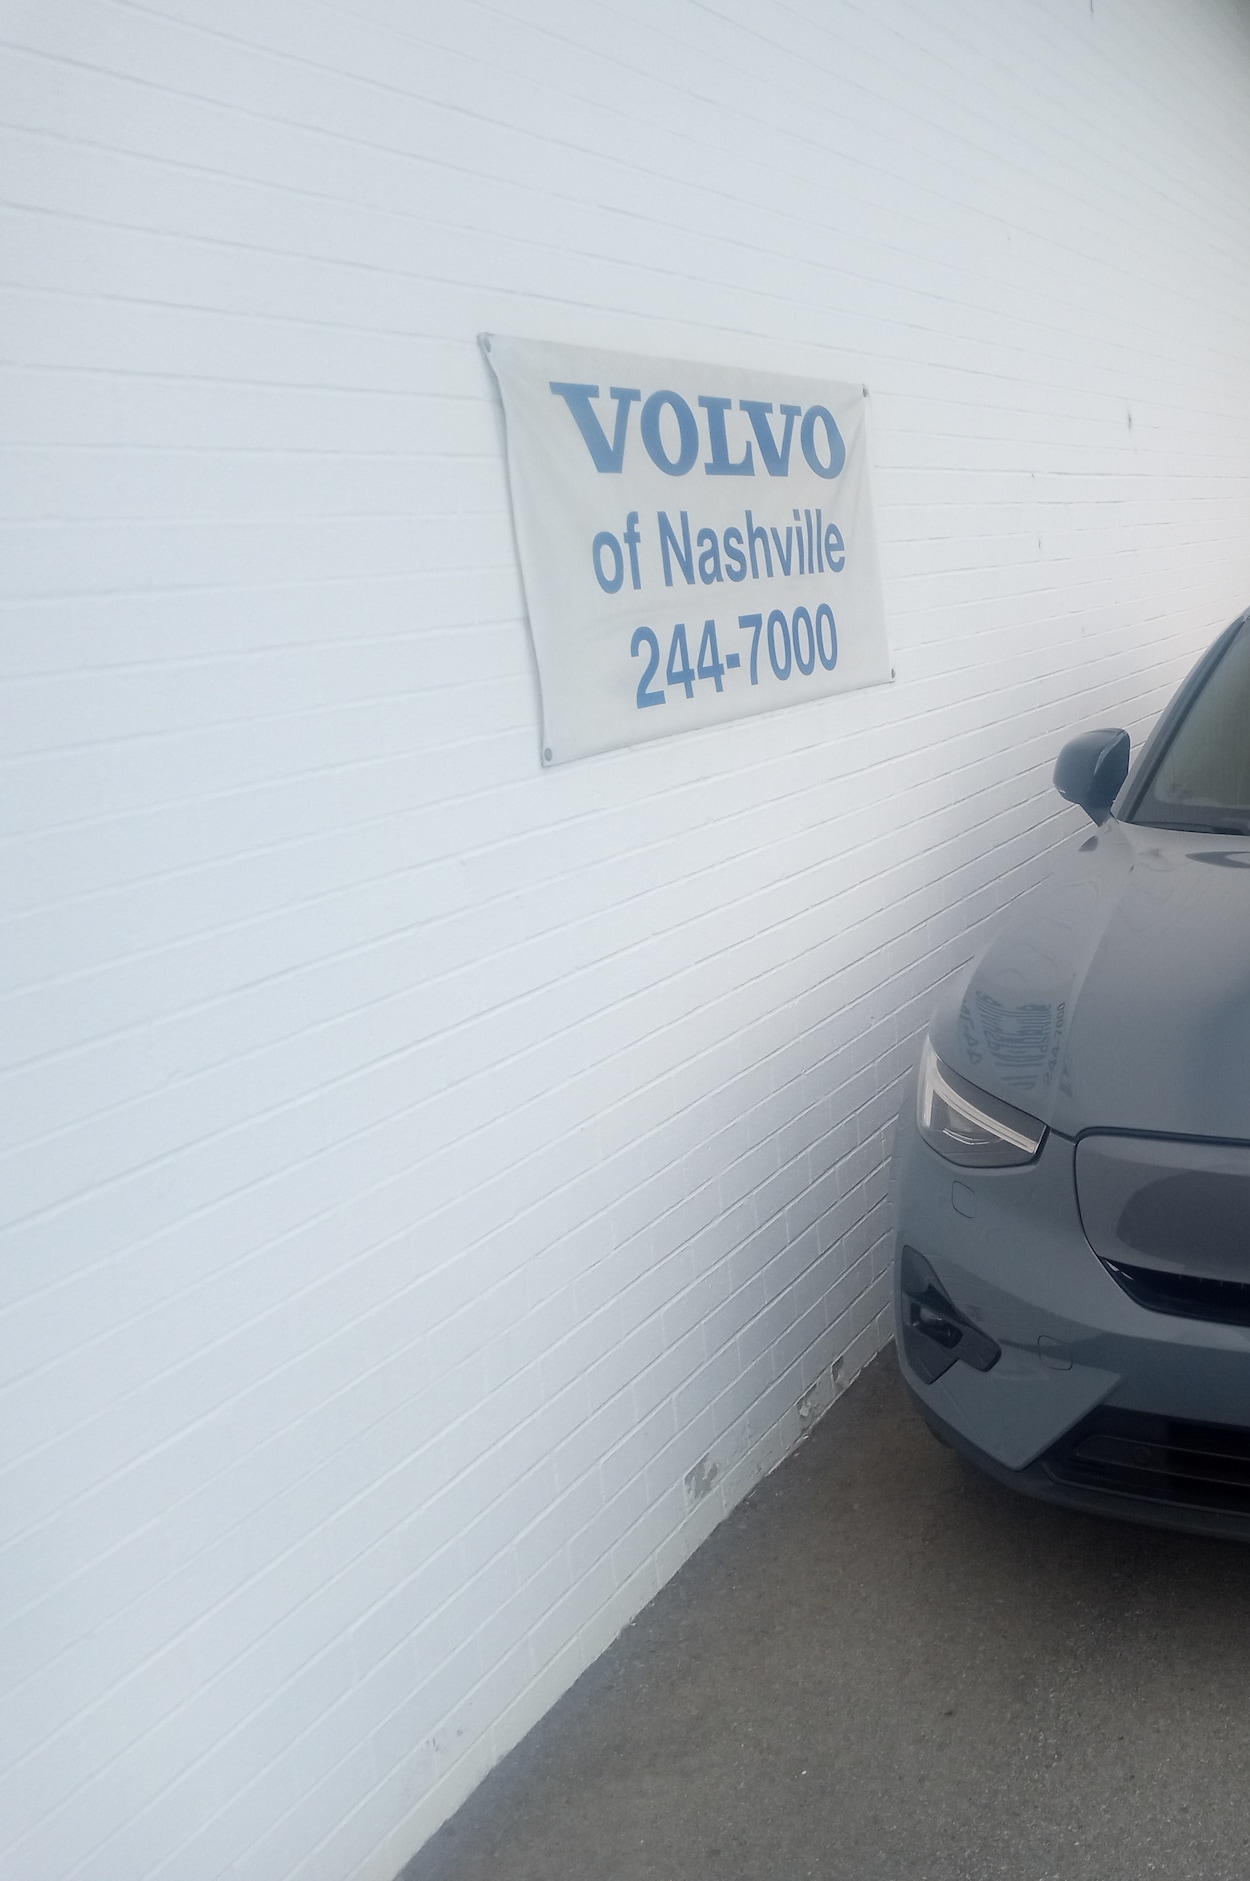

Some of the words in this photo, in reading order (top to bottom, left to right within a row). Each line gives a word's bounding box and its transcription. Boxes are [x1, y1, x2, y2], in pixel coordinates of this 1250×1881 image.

[548, 381, 846, 480] VOLVO
[592, 511, 641, 594] of
[656, 509, 846, 587] Nashville
[630, 602, 838, 709] 244-7000
